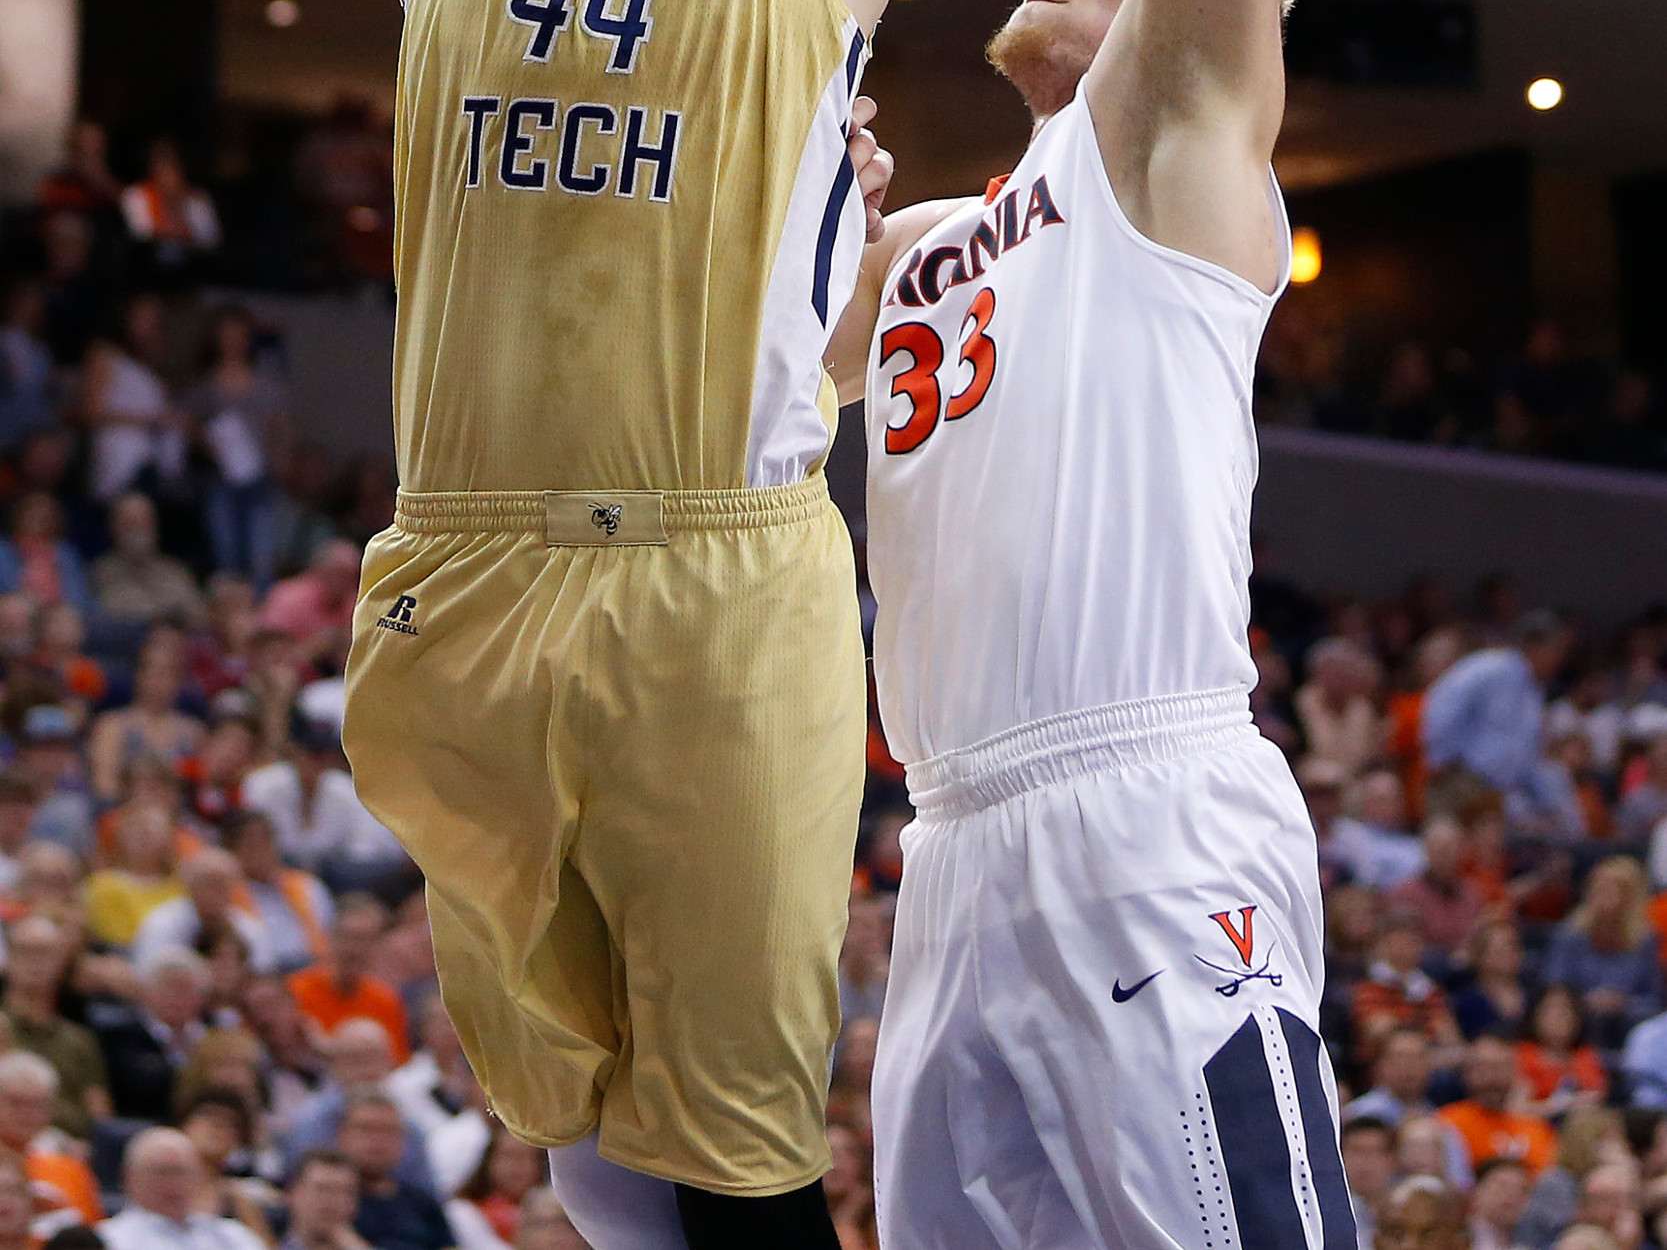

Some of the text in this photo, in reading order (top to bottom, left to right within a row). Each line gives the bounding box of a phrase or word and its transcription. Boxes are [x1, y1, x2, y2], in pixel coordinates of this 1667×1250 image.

[462, 95, 684, 203] TECH
[879, 287, 997, 455] 33
[376, 617, 419, 636] RUSSELL
